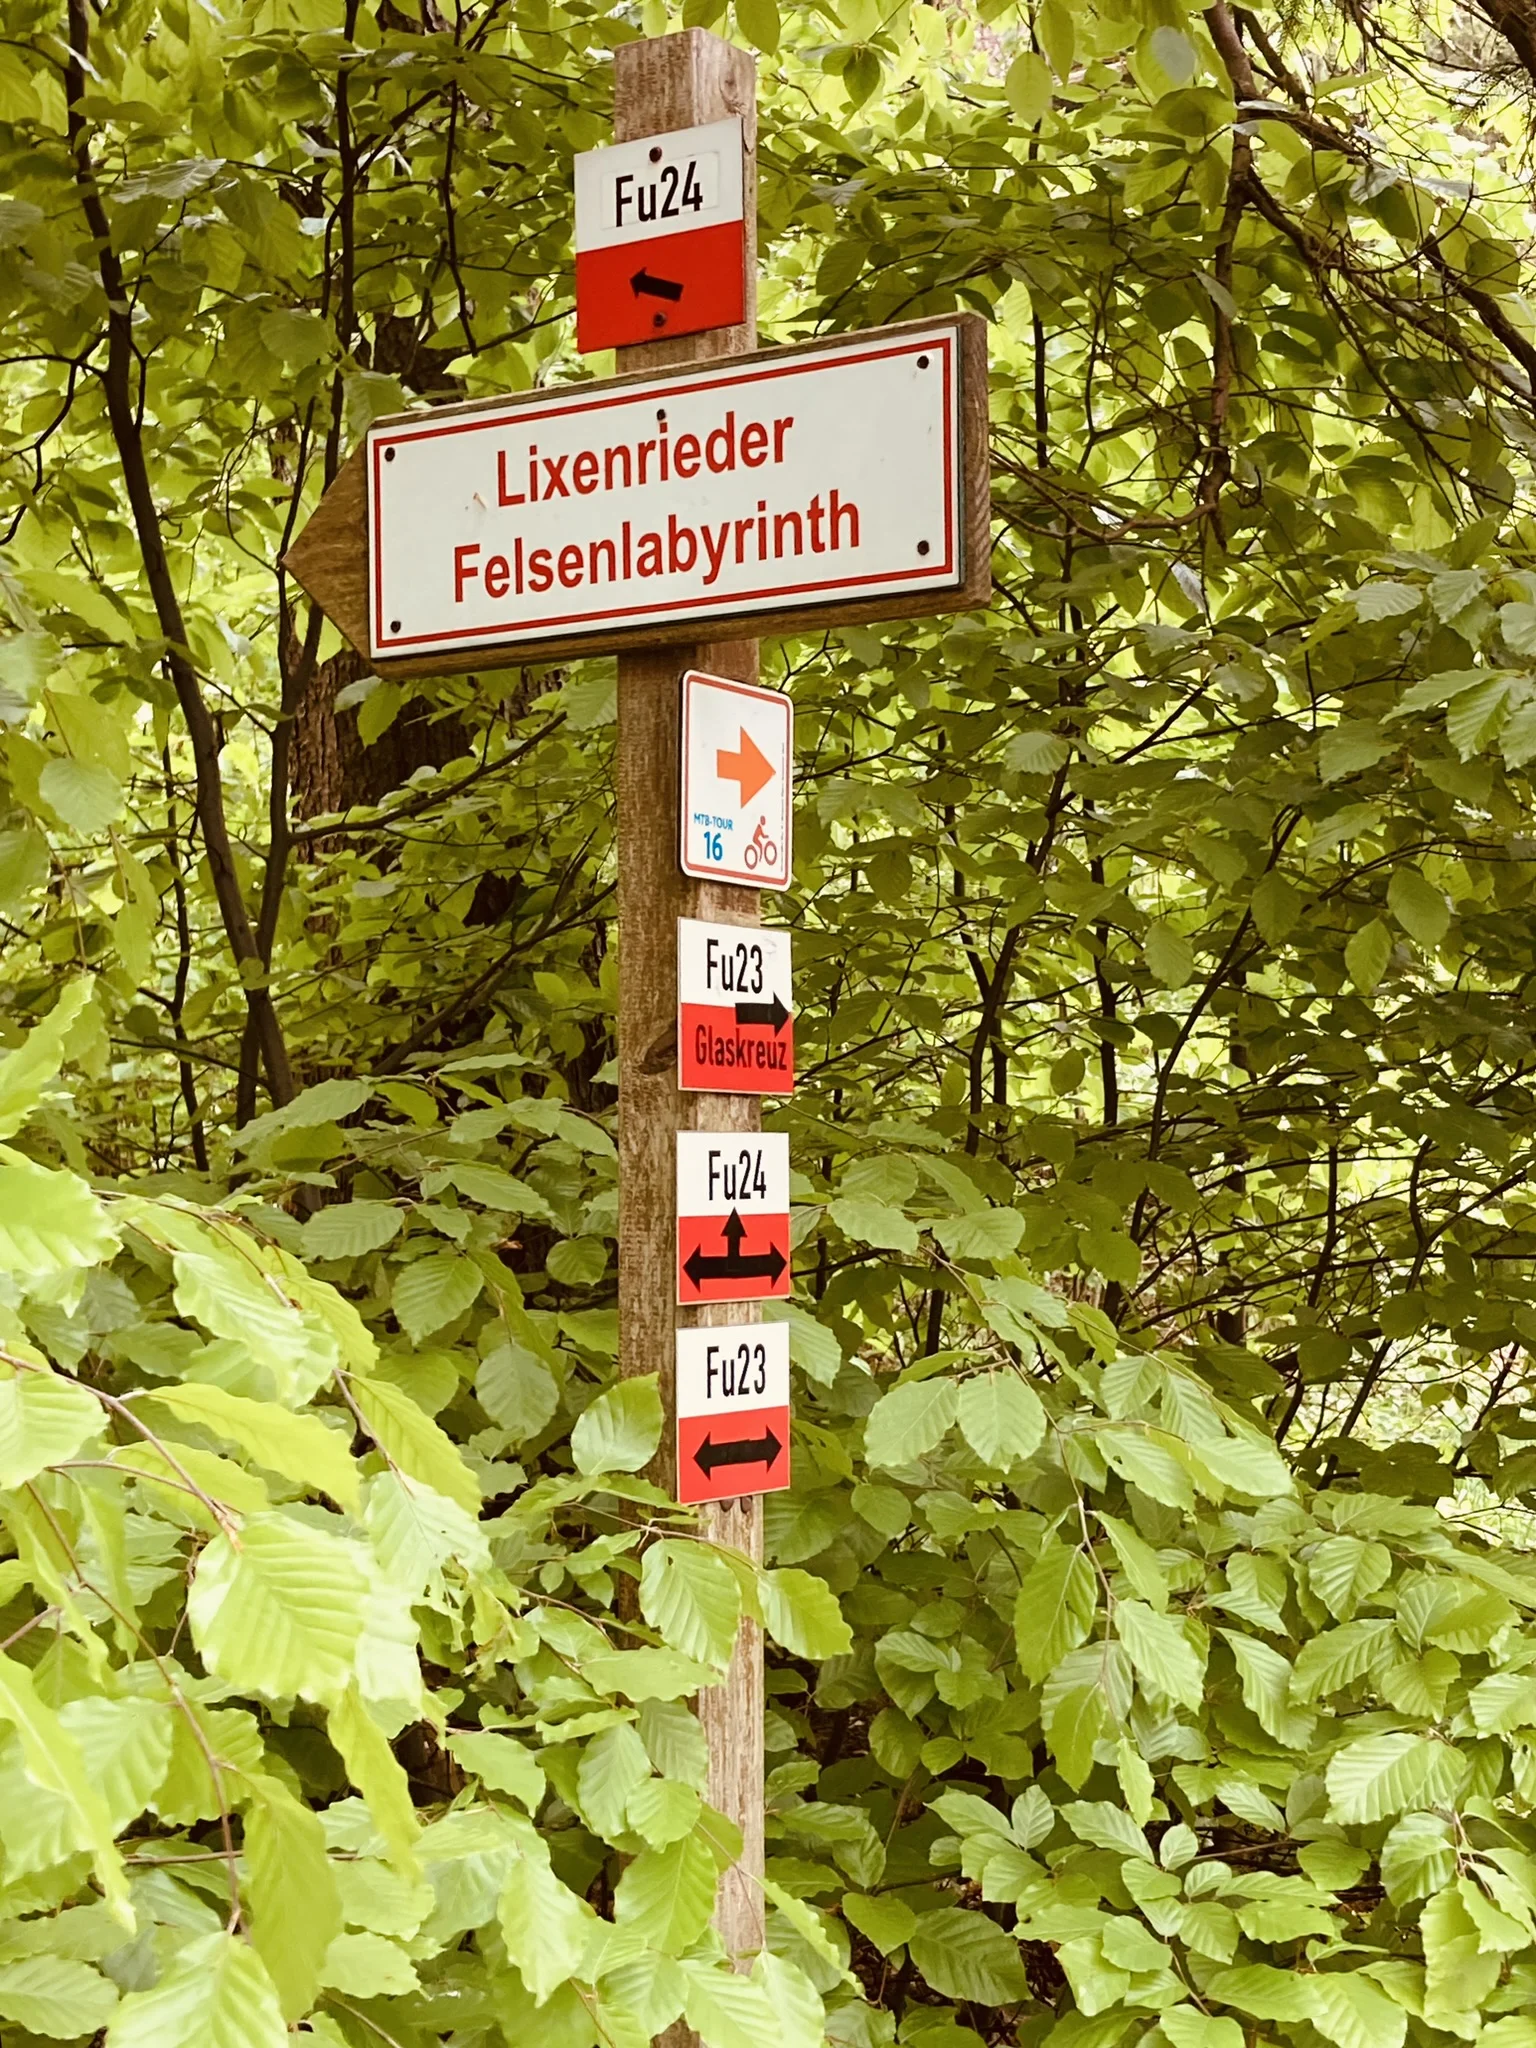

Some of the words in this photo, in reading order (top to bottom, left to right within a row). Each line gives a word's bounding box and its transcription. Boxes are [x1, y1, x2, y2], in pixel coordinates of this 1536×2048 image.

[615, 160, 703, 228] Fu24
[496, 410, 794, 507] Lixenrieder
[452, 488, 860, 603] Felsenlabyrinth
[693, 812, 734, 831] MTB-TOUR
[703, 831, 723, 861] 16
[706, 938, 763, 994] Fu23
[695, 1024, 787, 1071] Glaskreuz
[708, 1149, 767, 1201] Fu24
[706, 1343, 766, 1399] Fu23
